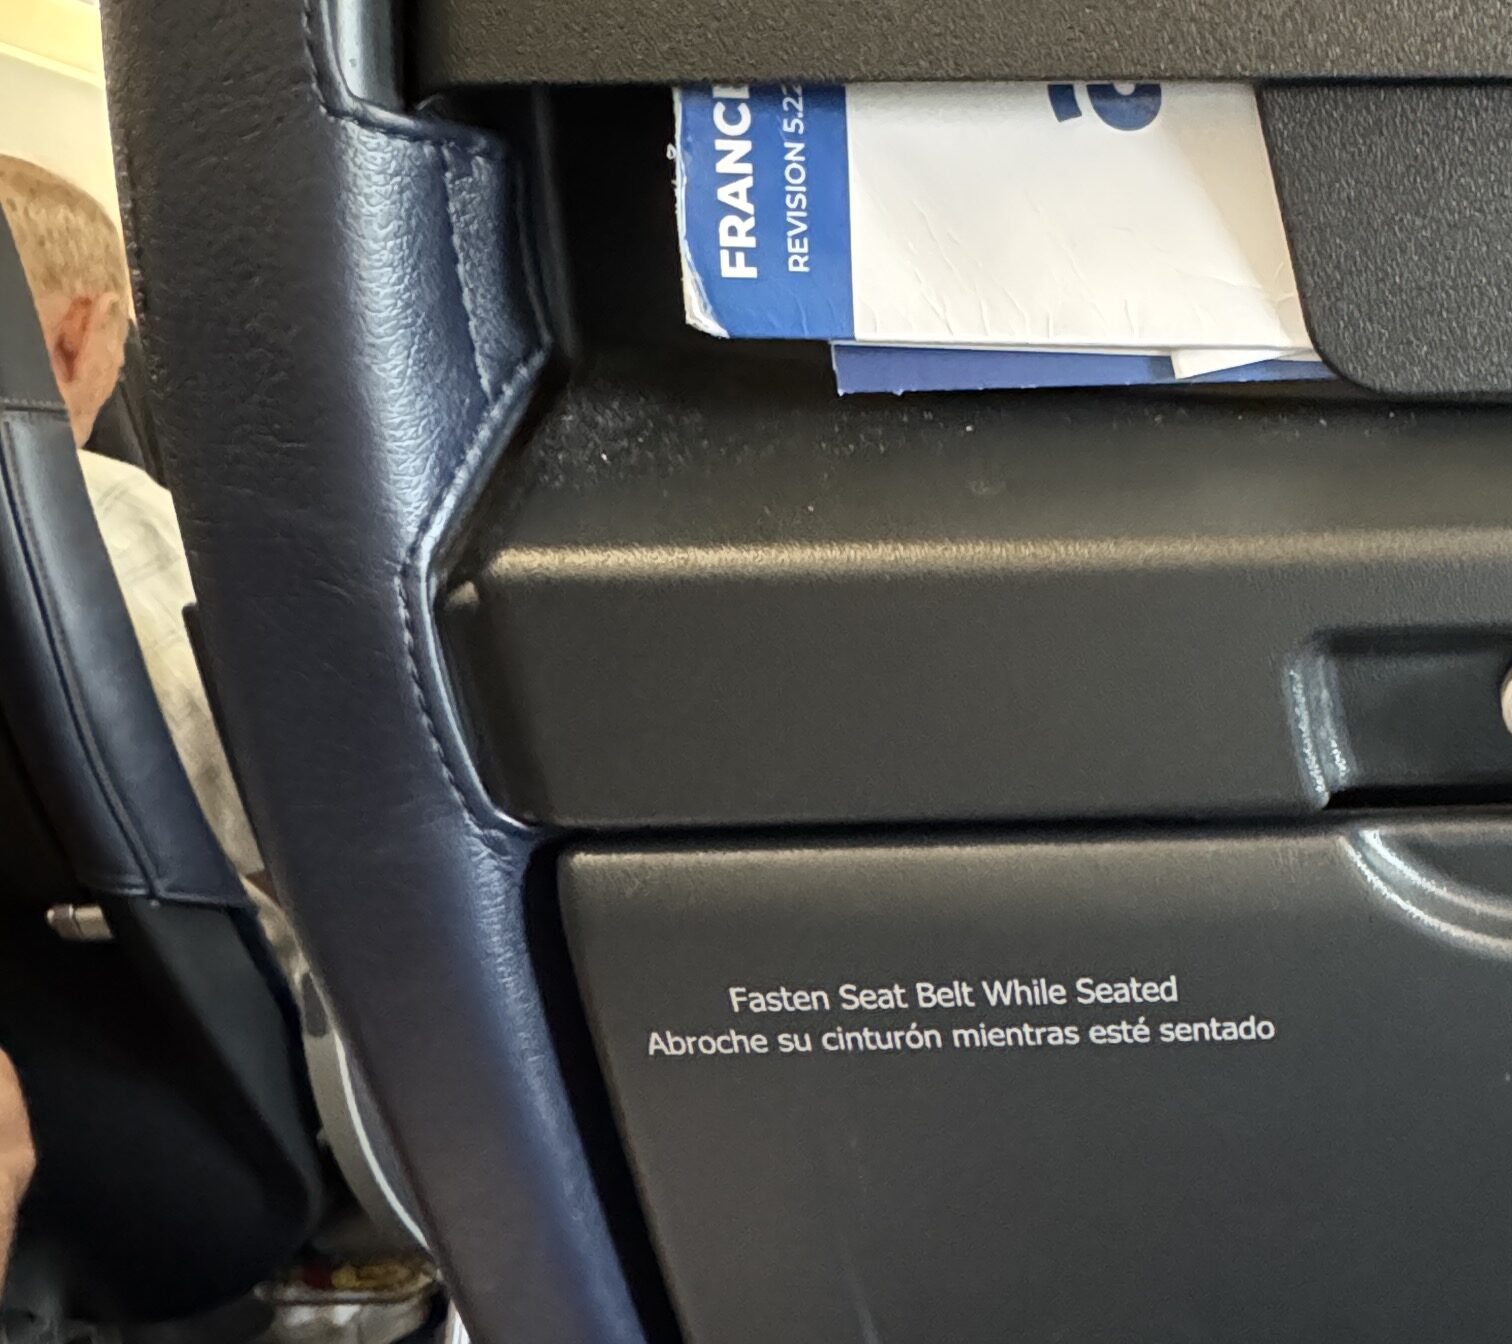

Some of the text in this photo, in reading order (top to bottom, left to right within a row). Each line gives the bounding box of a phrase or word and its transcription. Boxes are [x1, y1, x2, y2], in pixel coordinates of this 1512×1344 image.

[784, 141, 810, 273] REVISION
[727, 974, 1179, 1014] Fasten Seat Belt While Seated
[646, 1013, 1276, 1057] Abroche su cinturón mientras esté sentado
